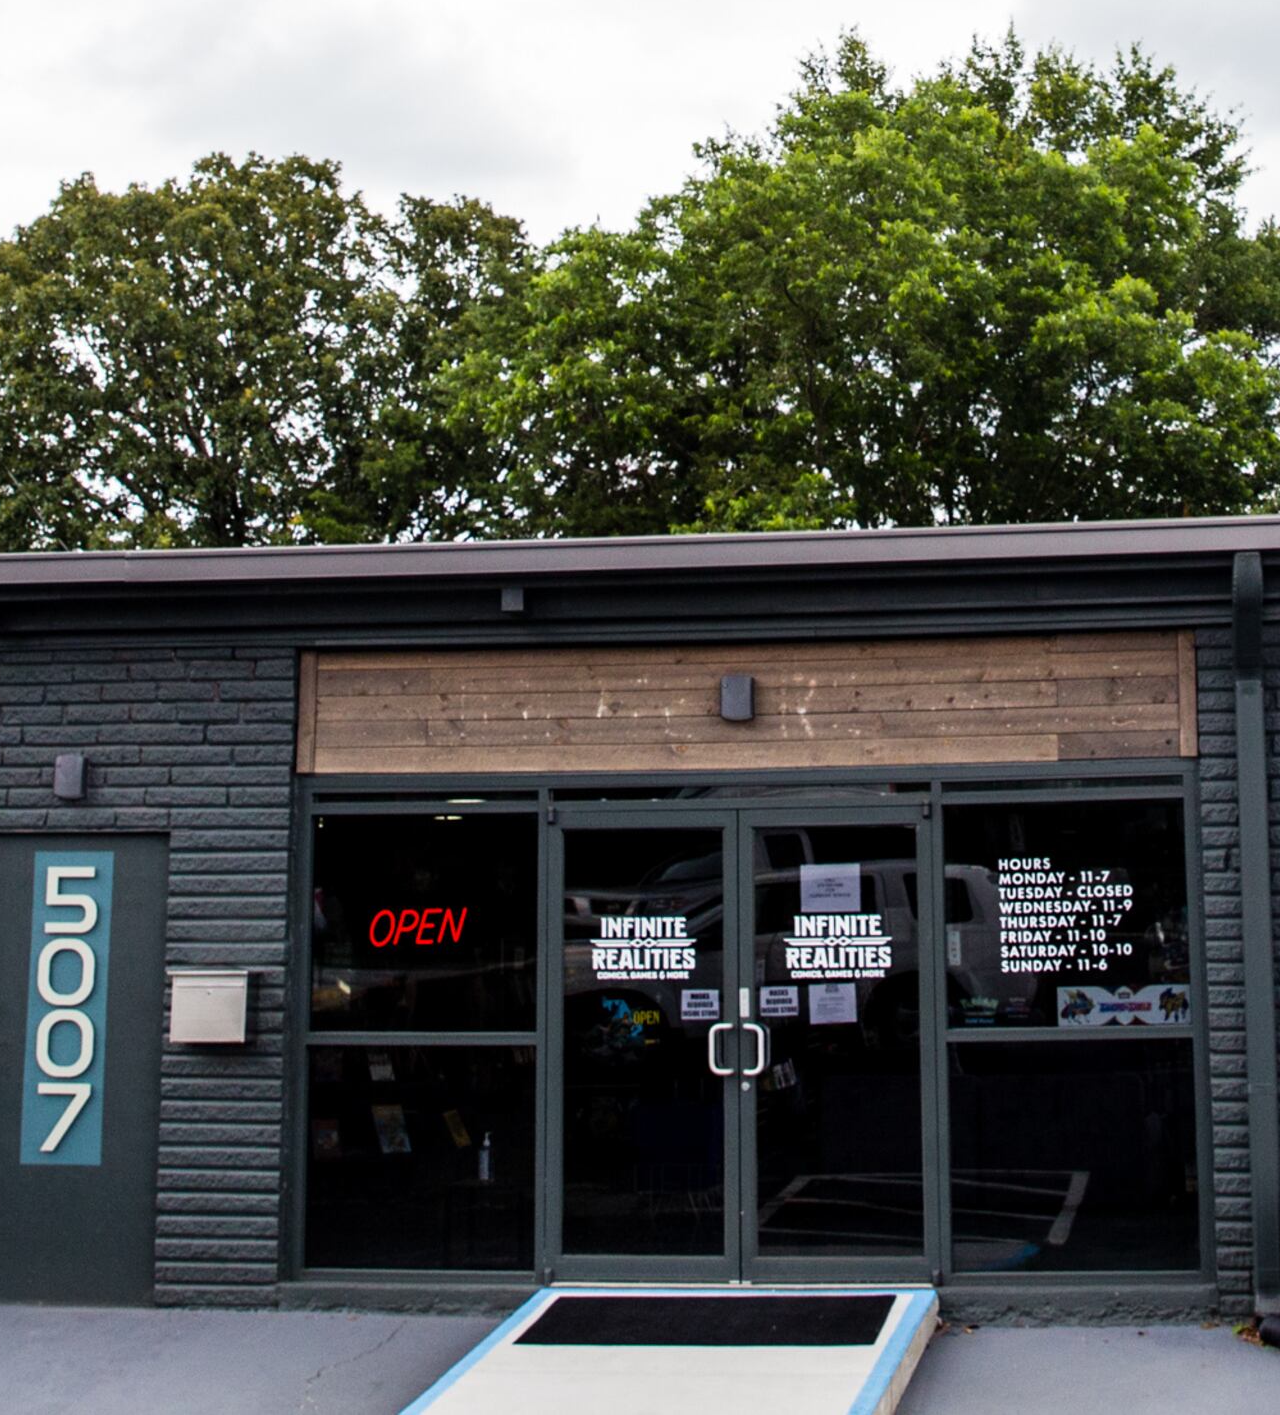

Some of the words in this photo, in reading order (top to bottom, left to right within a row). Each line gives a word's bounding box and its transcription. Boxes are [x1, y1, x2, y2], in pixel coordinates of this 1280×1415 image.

[998, 857, 1051, 871] HOURS
[998, 872, 1065, 886] MONDAY
[1080, 871, 1110, 883] 11-7
[998, 887, 1063, 900] TUESDAY
[1076, 884, 1133, 898] CLOSED
[1102, 899, 1133, 912] 11-9
[369, 907, 467, 948] OPEN
[601, 917, 687, 938] INFINITE
[793, 914, 882, 936] INFINITE
[999, 915, 1077, 929] THURSDAY
[1092, 914, 1122, 927] 11-7
[1000, 930, 1053, 944] FRIDAY
[1067, 929, 1106, 942] 11-10
[785, 947, 892, 969] REALITIES
[1000, 944, 1077, 958] SATURDAY
[1092, 943, 1133, 956] 10-10
[592, 949, 696, 970] REALITIES
[1001, 959, 1063, 973] SUNDAY
[1077, 958, 1108, 971] 11-6
[630, 971, 658, 980] GAMES
[666, 971, 689, 980] MORE
[825, 970, 853, 978] GAMES
[862, 969, 885, 978] MORE
[37, 865, 98, 1152] 5007
[633, 1010, 660, 1025] OPEN
